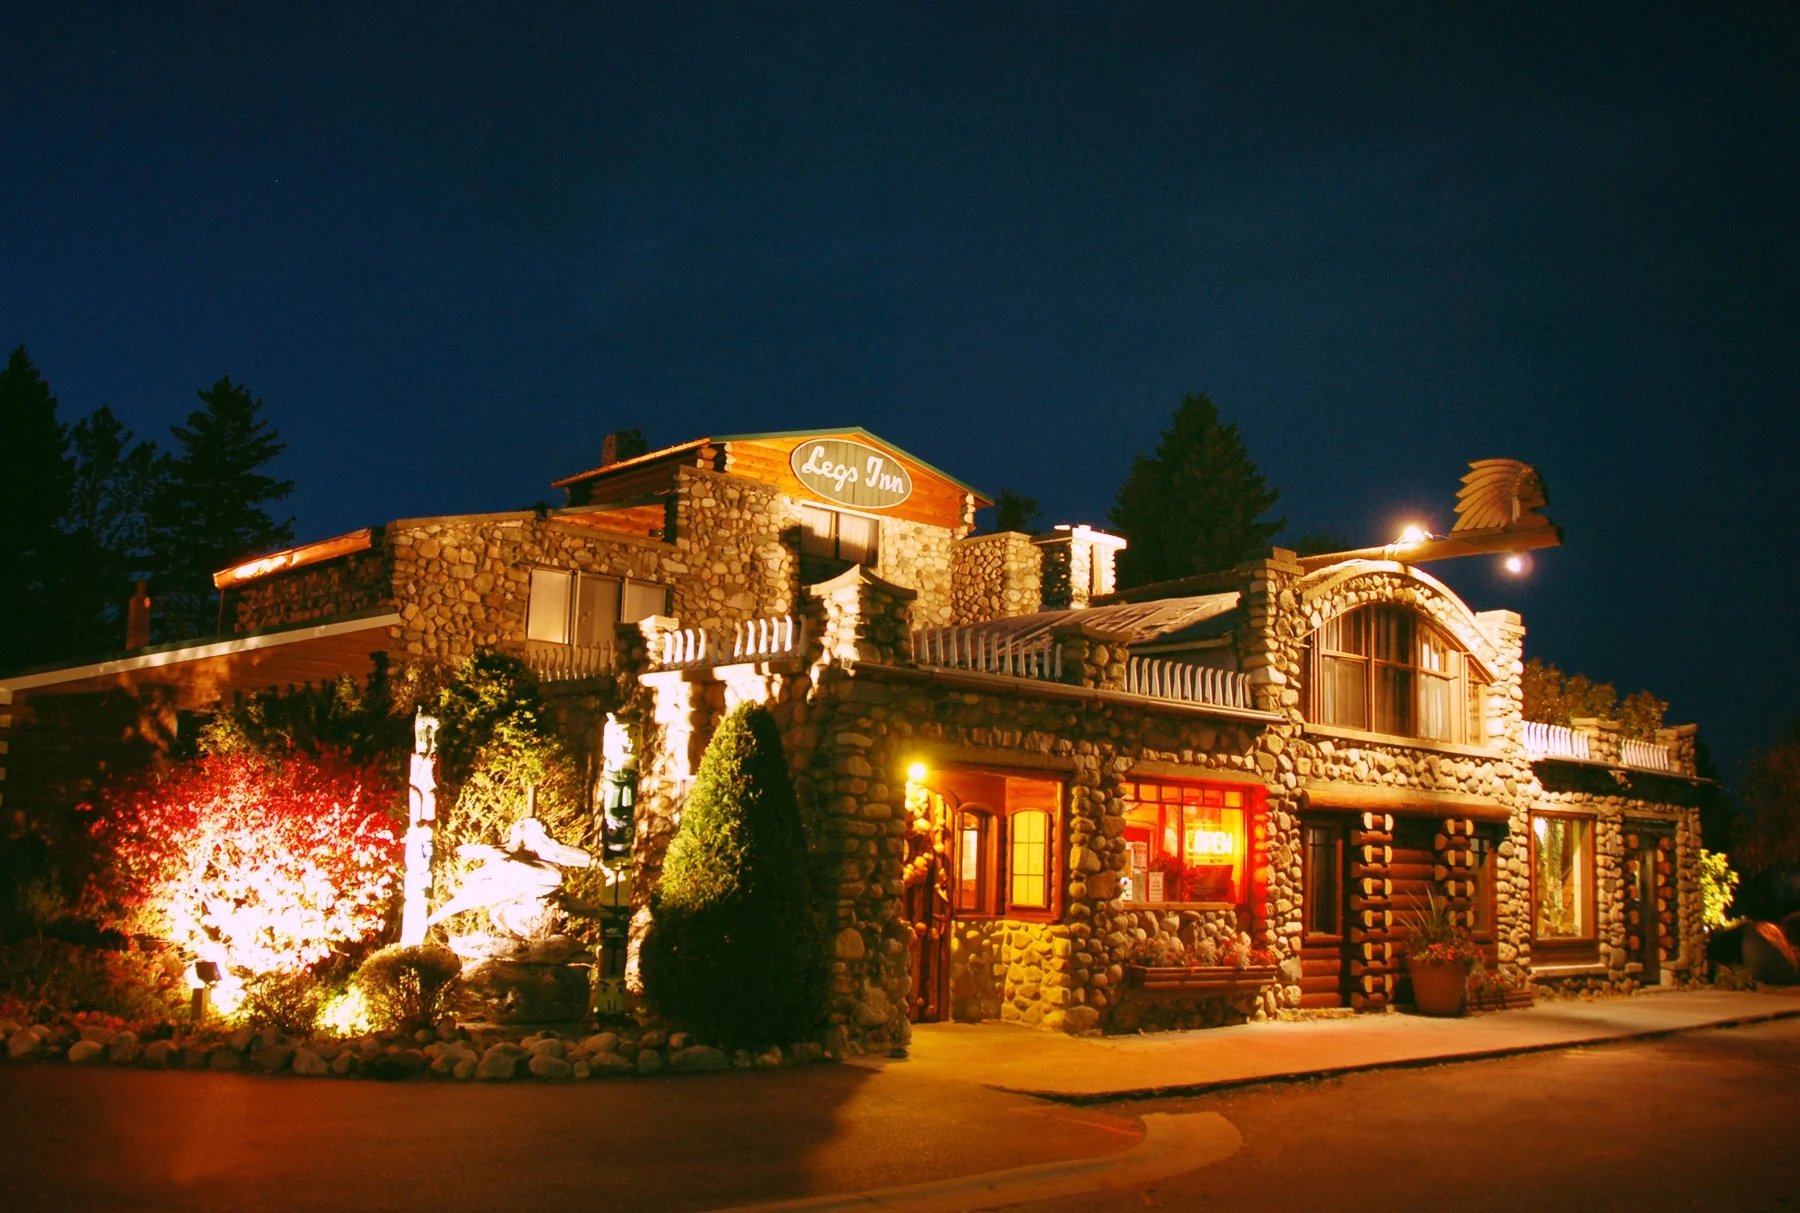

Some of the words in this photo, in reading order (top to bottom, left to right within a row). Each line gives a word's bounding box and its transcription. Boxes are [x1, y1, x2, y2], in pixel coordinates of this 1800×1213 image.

[801, 445, 858, 492] Legs
[865, 456, 904, 494] Inn
[1193, 829, 1232, 855] OPEN
